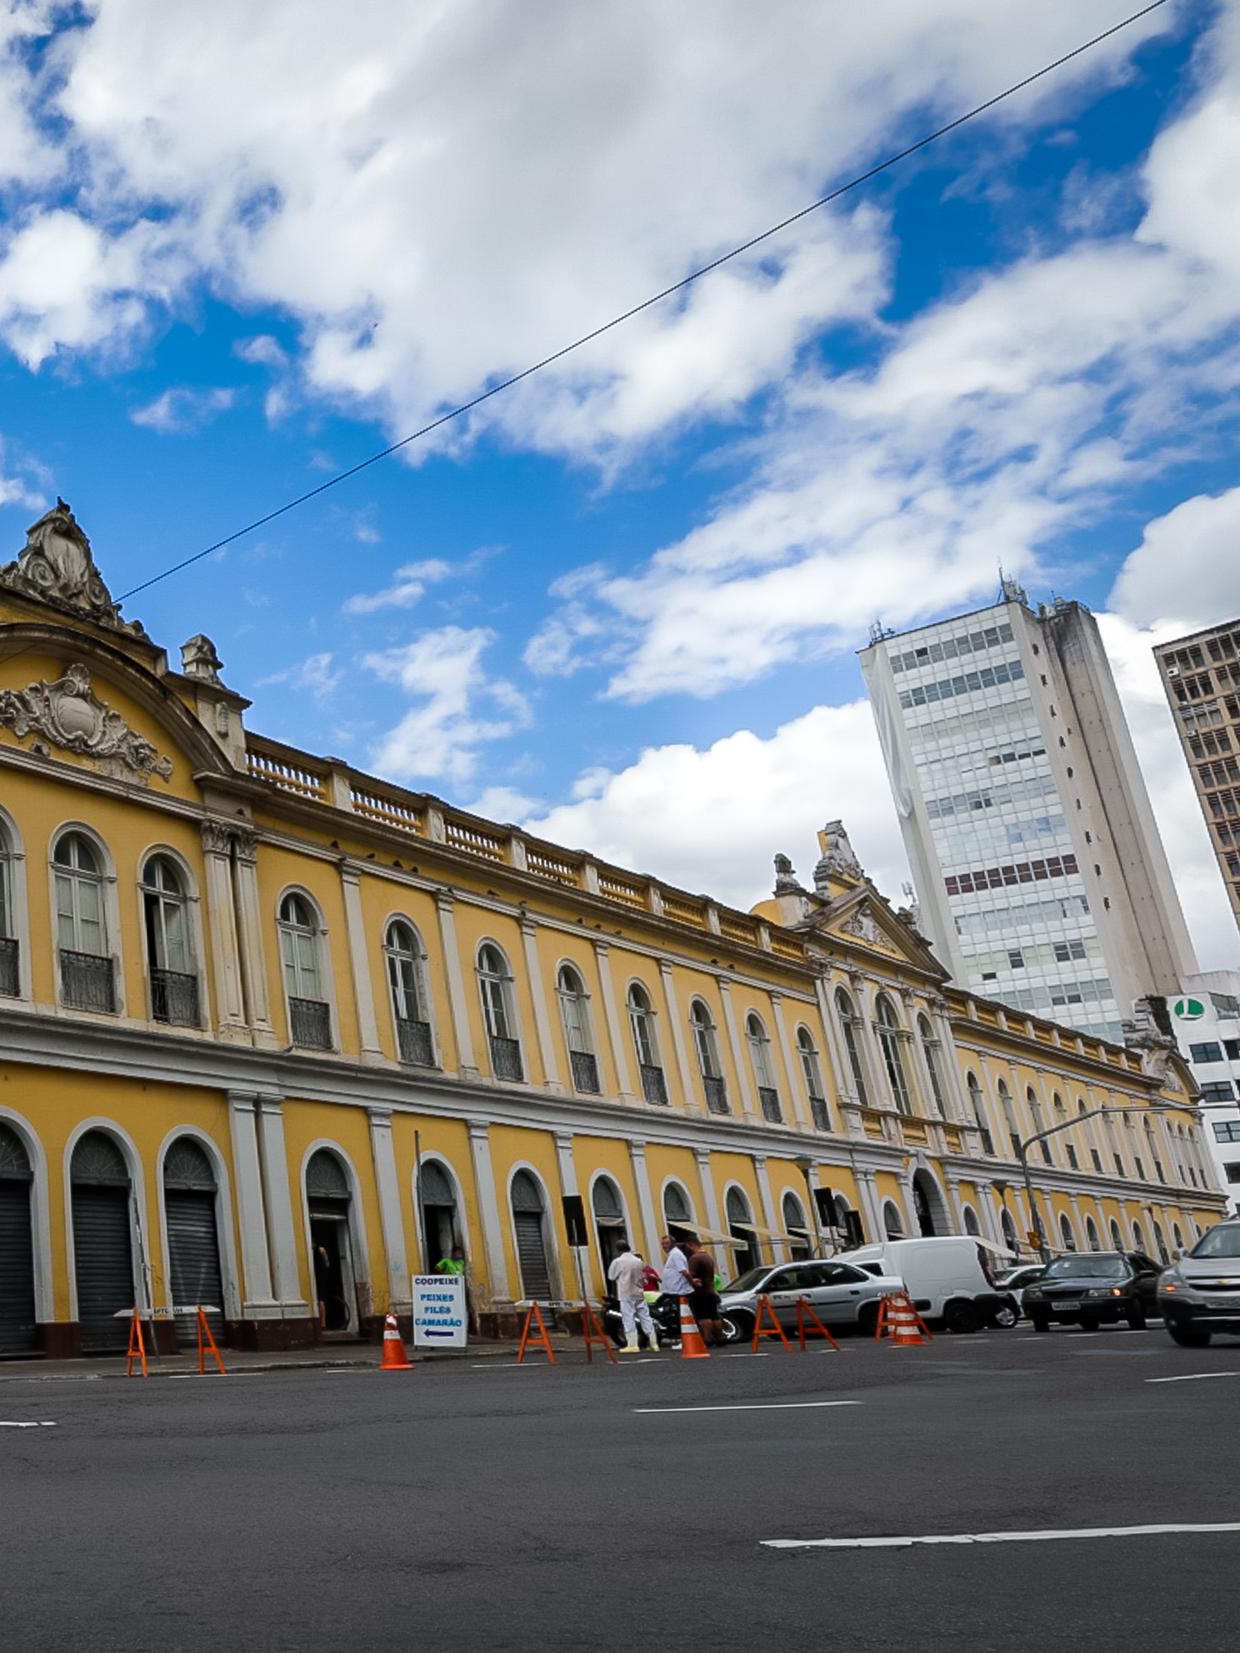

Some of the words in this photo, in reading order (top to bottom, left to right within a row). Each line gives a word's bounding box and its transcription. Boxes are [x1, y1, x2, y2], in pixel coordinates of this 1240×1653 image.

[415, 1277, 459, 1286] COOPEIXE
[420, 1293, 455, 1302] PEIXES
[415, 1317, 462, 1327] CAMARÃO
